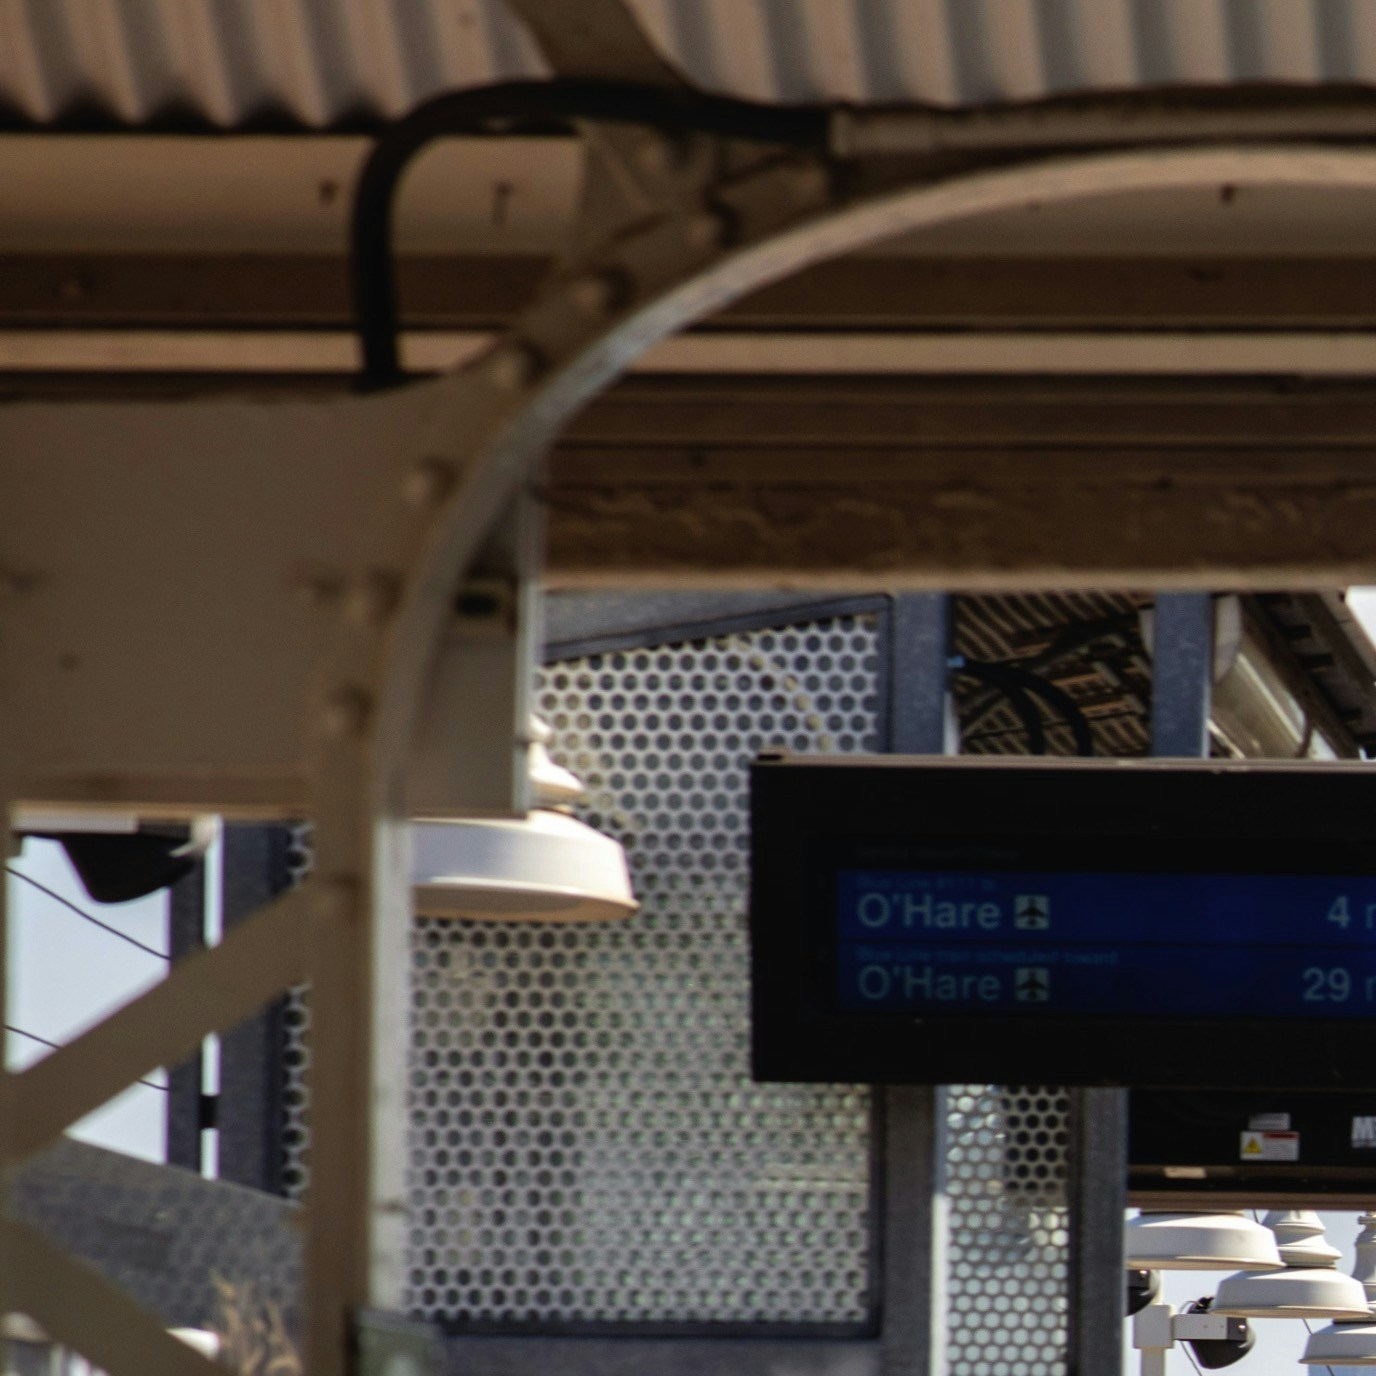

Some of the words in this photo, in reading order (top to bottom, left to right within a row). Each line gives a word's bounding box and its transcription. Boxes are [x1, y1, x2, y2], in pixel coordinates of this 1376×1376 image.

[856, 892, 1002, 930] O'Hare
[1326, 895, 1352, 929] 4
[856, 964, 1002, 1001] O'Hare
[1302, 966, 1352, 1002] 29
